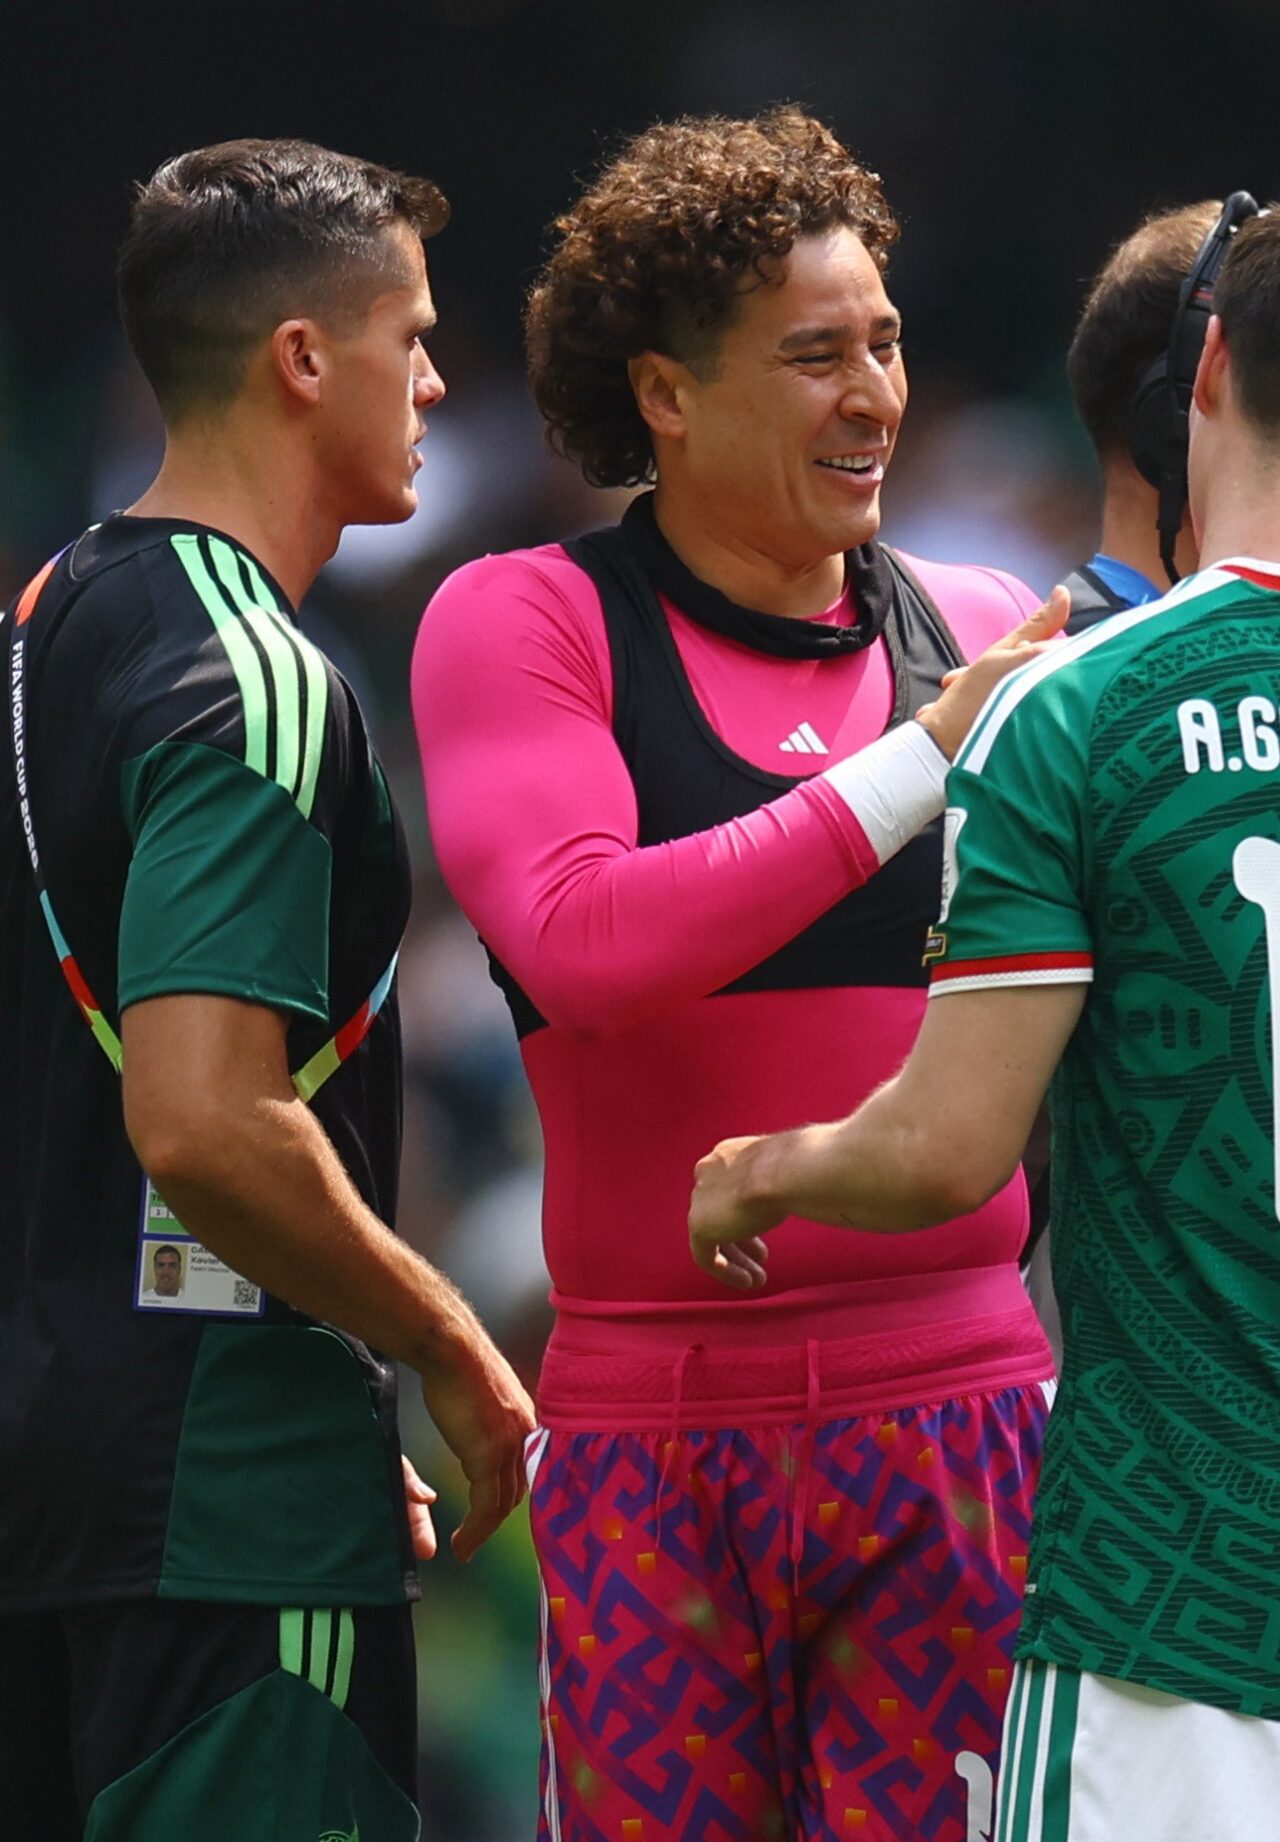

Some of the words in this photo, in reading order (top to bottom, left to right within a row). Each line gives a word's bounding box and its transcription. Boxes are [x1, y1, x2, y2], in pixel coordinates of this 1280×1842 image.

[12, 639, 24, 686] FIFA
[12, 683, 24, 756] WORLD
[16, 757, 27, 796] CUP
[20, 798, 39, 870] 2026
